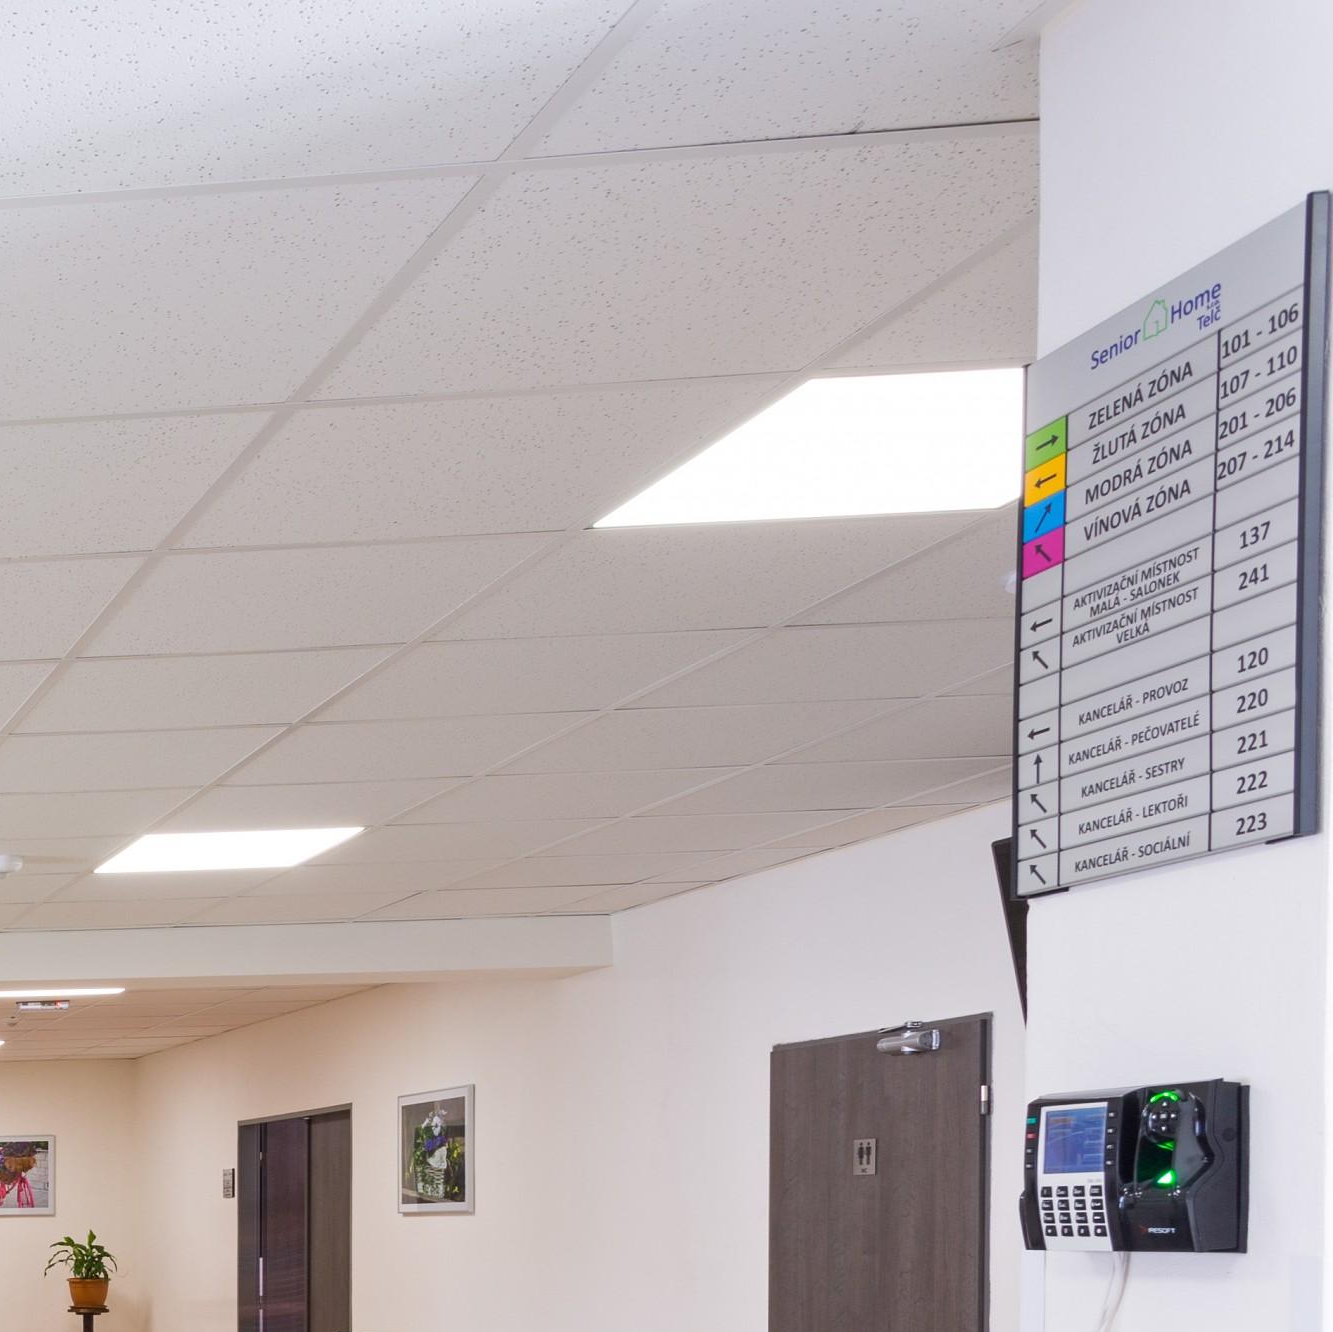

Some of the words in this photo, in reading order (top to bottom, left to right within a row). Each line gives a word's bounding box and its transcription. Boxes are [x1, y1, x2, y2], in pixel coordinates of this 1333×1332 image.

[1091, 329, 1141, 370] Senior
[1171, 282, 1221, 324] Home
[1197, 306, 1221, 330] Telč
[1222, 329, 1251, 359] 101
[1268, 303, 1299, 334] 106
[1089, 382, 1143, 430] ZELENÁ
[1148, 361, 1193, 398] ZÓNA
[1221, 370, 1249, 400] 107
[1267, 346, 1297, 376] 110
[1093, 424, 1137, 464] ŽLUTÁ
[1141, 404, 1186, 440] ZÓNA
[1219, 412, 1248, 440] 201
[1265, 388, 1296, 418] 206
[1085, 459, 1143, 504] MODRÁ
[1147, 440, 1193, 474] ZÓNA
[1217, 452, 1247, 480] 207
[1264, 430, 1295, 458] 214
[1083, 499, 1141, 540] VÍNOVÁ
[1146, 480, 1191, 513] ZÓNA
[1239, 521, 1271, 550] 137
[1073, 570, 1139, 610] AKTIVIZAČNÍ
[1141, 547, 1199, 580] MÍSTNOST
[1089, 592, 1121, 618] MALÁ
[1130, 571, 1180, 602] SALONEK
[1238, 564, 1269, 590] 241
[1072, 609, 1138, 648] AKTIVIZAČNÍ
[1140, 587, 1199, 620] MÍSTNOST
[1116, 622, 1150, 644] VELKÁ
[1237, 648, 1269, 674] 120
[1078, 696, 1133, 726] KANCELÁŘ
[1142, 678, 1189, 704] PROVOZ
[1236, 688, 1269, 714] 220
[1068, 736, 1122, 765] KANCELÁŘ
[1131, 710, 1200, 746] PEČOVATELÉ
[1236, 730, 1268, 754] 221
[1081, 772, 1136, 798] KANCELÁŘ
[1145, 758, 1185, 780] SESTRY
[1236, 771, 1268, 794] 222
[1078, 809, 1133, 836] KANCELÁŘ
[1142, 795, 1189, 818] LEKTOŘI
[1236, 812, 1267, 836] 223
[1074, 846, 1129, 873] KANCELÁŘ
[1138, 831, 1191, 858] SOCIÁLNÍ
